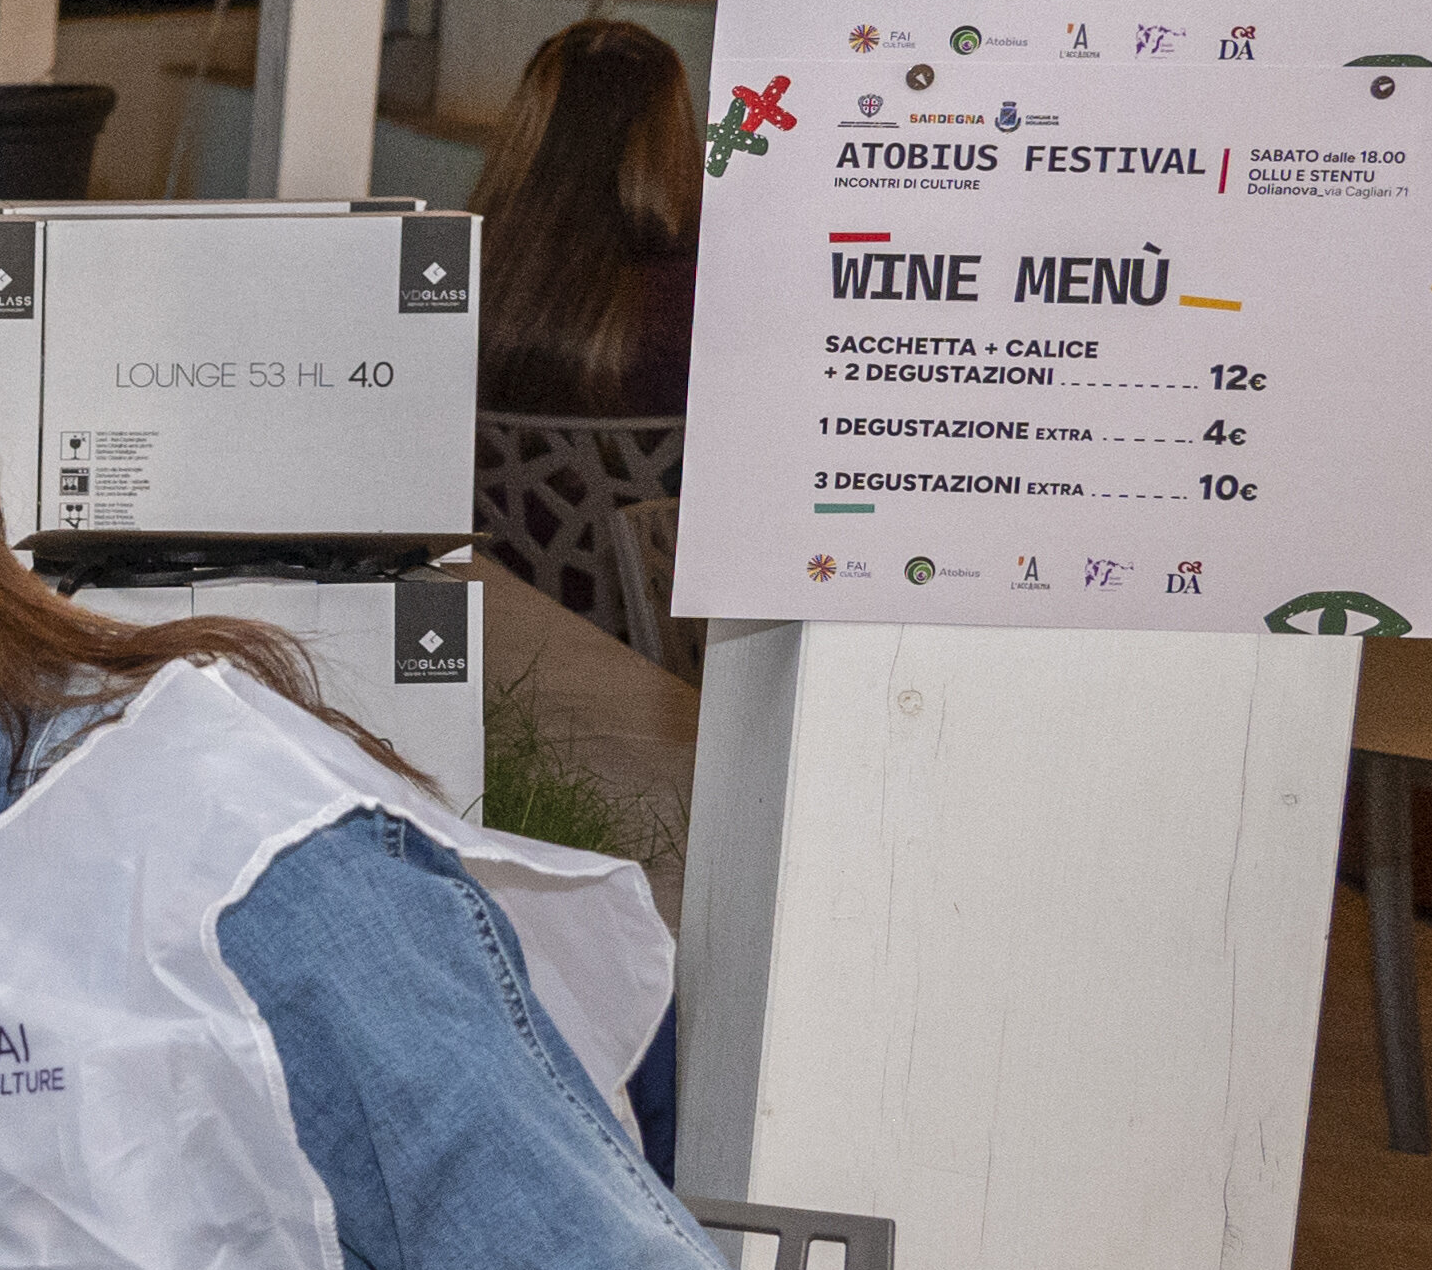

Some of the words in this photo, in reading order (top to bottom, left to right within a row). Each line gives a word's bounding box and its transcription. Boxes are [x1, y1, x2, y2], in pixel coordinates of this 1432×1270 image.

[889, 31, 910, 41] FAI
[985, 36, 1028, 47] Atobius
[909, 113, 985, 124] SARDEGNA
[836, 142, 998, 171] ATOBIUS
[1024, 145, 1205, 175] FESTIVAL
[1250, 149, 1319, 162] SABATO
[1322, 151, 1355, 163] dalle
[1360, 151, 1405, 163] 18.00
[1248, 169, 1291, 181] OLLU
[1296, 169, 1304, 181] E
[1309, 170, 1375, 182] STENTU
[834, 177, 899, 189] INCONTRI
[903, 179, 916, 189] DI
[920, 178, 980, 190] CULTURE
[1345, 186, 1391, 199] Cagliari
[1395, 187, 1408, 197] 71
[831, 252, 981, 302] WINE
[1014, 241, 1170, 307] MENÙ
[401, 289, 467, 301] VDGLASS
[825, 335, 976, 356] SACCHETTA
[1005, 339, 1098, 359] CALICE
[115, 362, 236, 388] LOUNGE
[249, 362, 285, 388] 53
[298, 362, 334, 388] HL
[348, 361, 394, 388] 4.0
[844, 363, 860, 381] 2
[866, 364, 1053, 385] DEGUSTAZIONI
[1210, 364, 1267, 391] 12€
[819, 417, 828, 435] 1
[835, 417, 1030, 440] DEGUSTAZIONE
[1035, 428, 1093, 441] EXTRA
[1203, 419, 1247, 446] 4€
[814, 472, 827, 489] 3
[834, 472, 1021, 495] DEGUSTAZIONI
[1027, 482, 1084, 497] EXTRA
[1199, 474, 1258, 501] 10€
[846, 561, 867, 571] FAI
[939, 567, 981, 578] Atobius
[397, 657, 465, 670] VDGLASS
